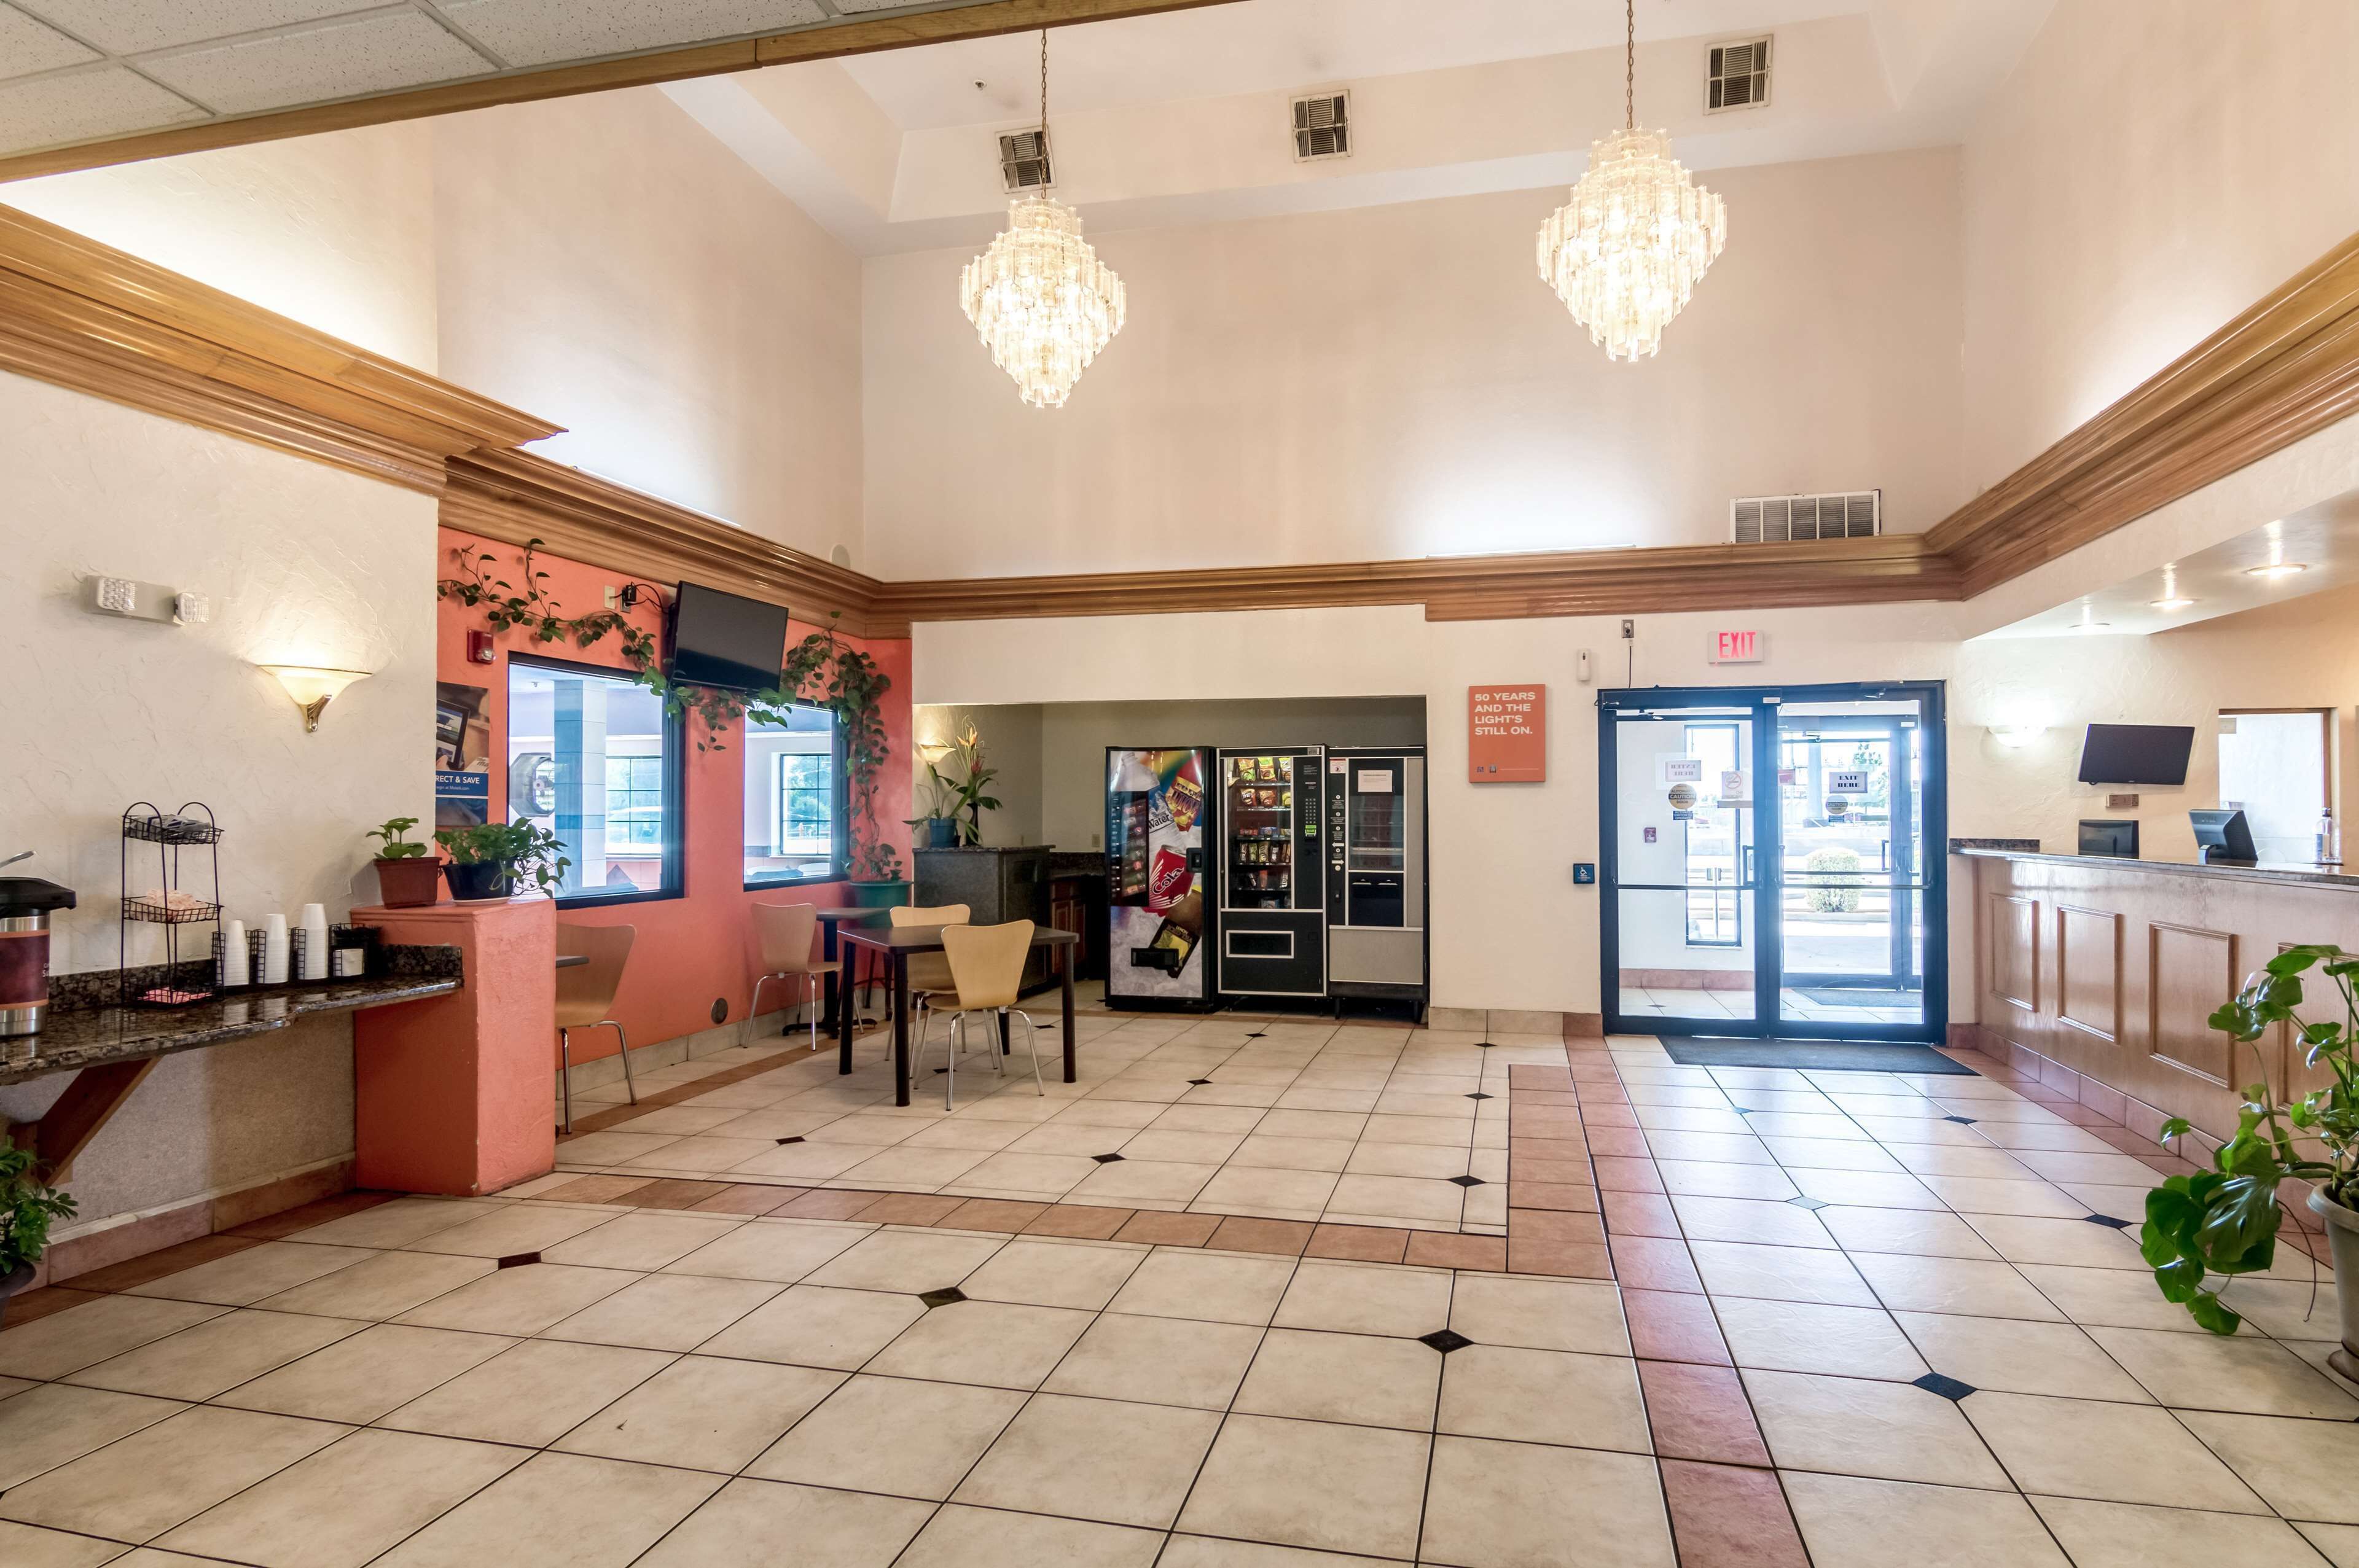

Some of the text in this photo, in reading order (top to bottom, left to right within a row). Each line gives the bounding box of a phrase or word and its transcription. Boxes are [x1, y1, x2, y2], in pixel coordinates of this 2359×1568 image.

[1719, 631, 1756, 658] EXIT
[1493, 692, 1536, 701] YEARS
[1474, 703, 1532, 712] AND THE
[1475, 715, 1523, 724] LIGHT'S
[1474, 726, 1533, 735] STILL ON.
[1149, 814, 1170, 829] Water
[1152, 867, 1185, 895] Cola
